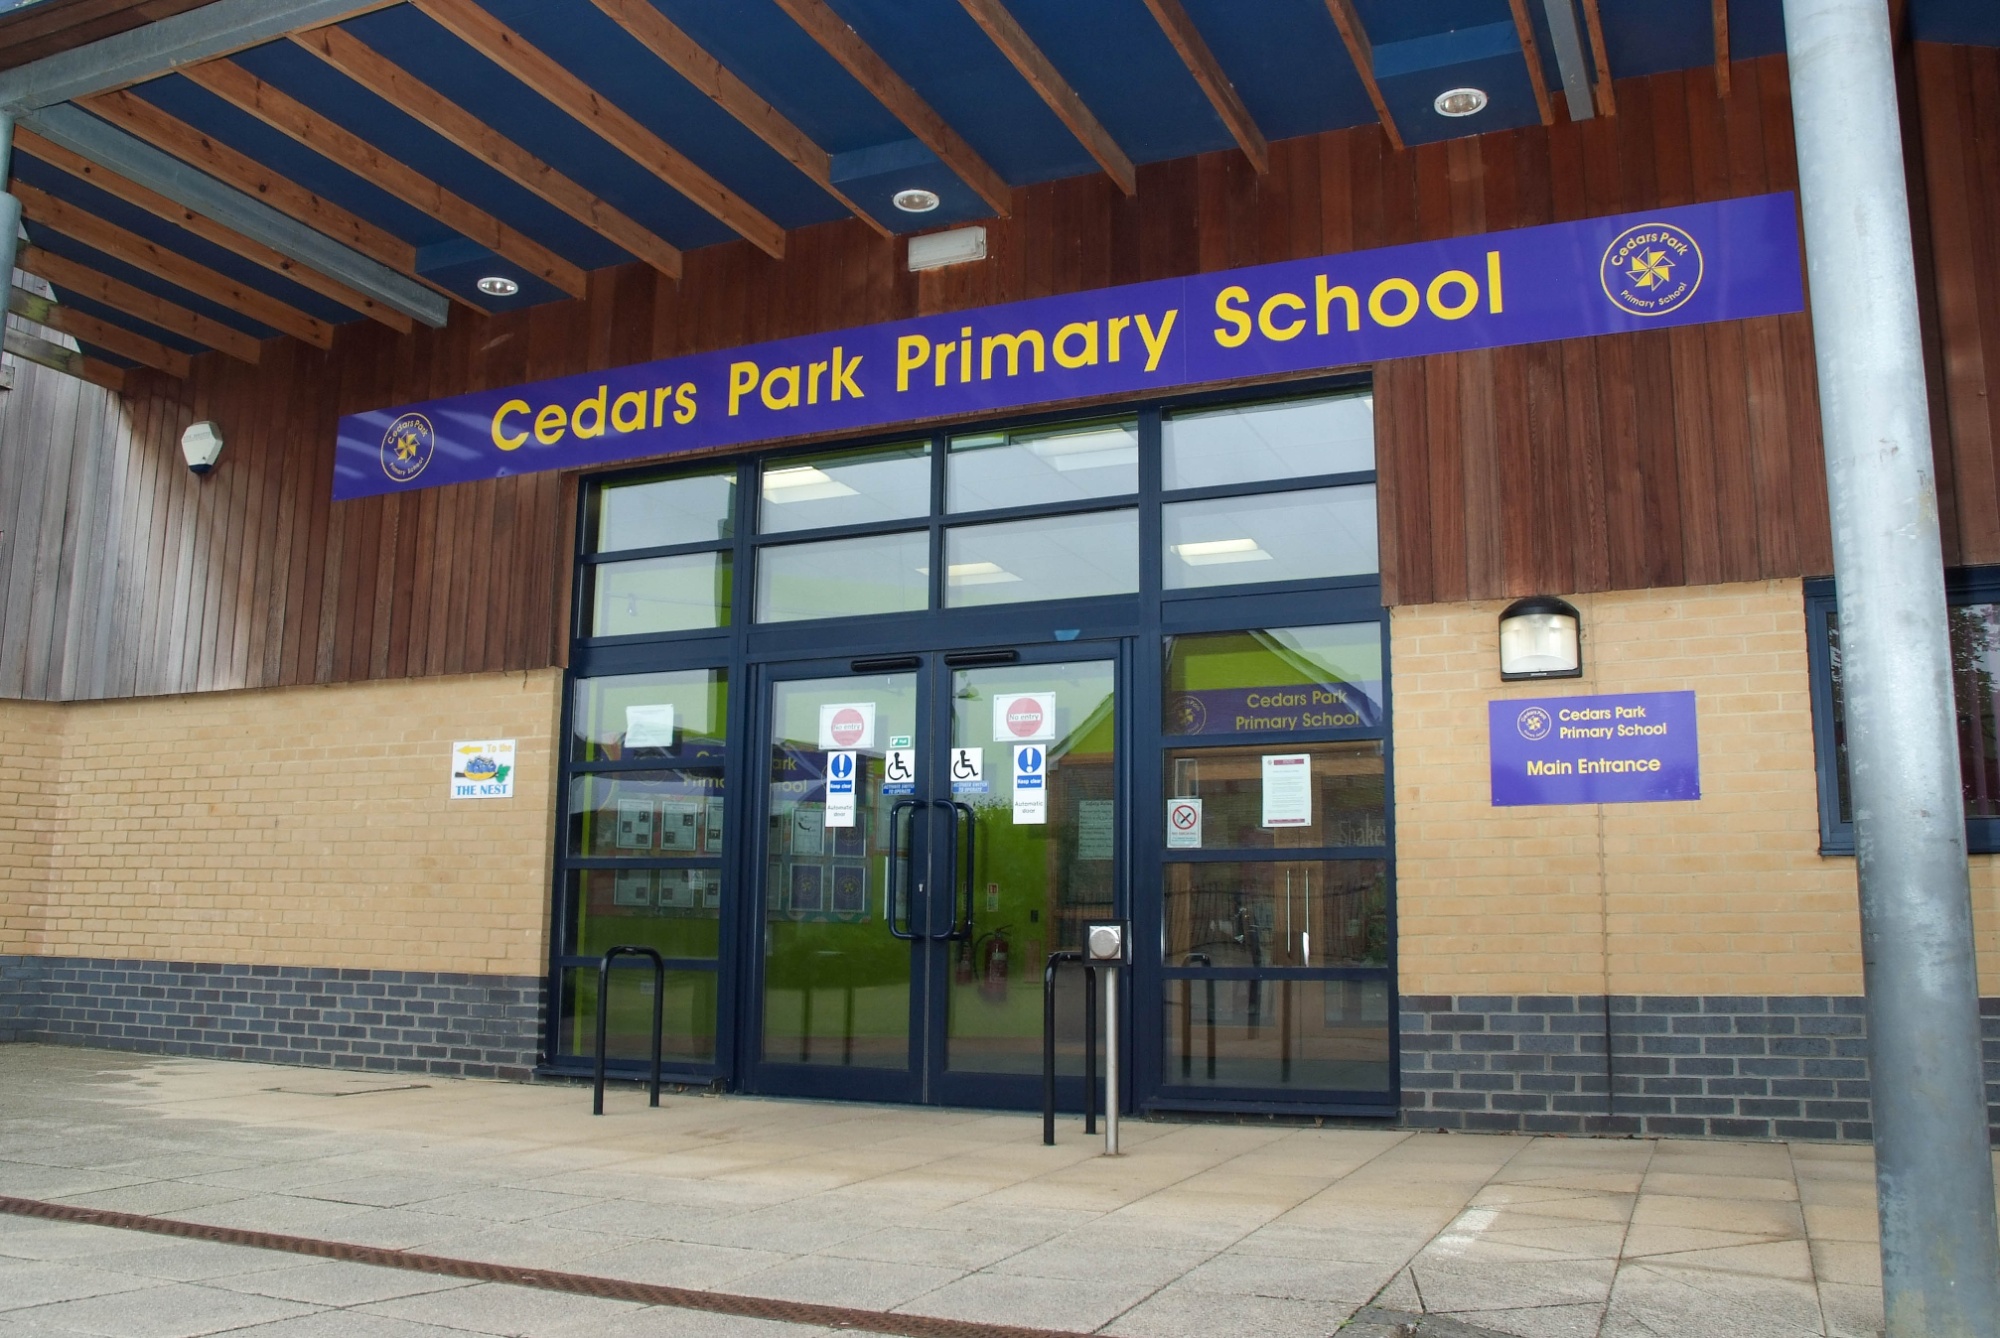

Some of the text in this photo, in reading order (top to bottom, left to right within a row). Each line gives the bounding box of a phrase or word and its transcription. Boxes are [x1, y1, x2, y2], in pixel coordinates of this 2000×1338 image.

[1611, 232, 1688, 266] Cedars Park
[1620, 282, 1688, 308] Primary School
[491, 250, 1504, 452] Cedars Park Primary School
[387, 419, 428, 445] Cedars Park
[1247, 689, 1347, 709] Cedars Park
[1020, 713, 1040, 722] entry
[1236, 712, 1360, 731] Primary School
[1558, 705, 1647, 722] Cedars Park
[1559, 725, 1614, 741] Primary
[1617, 722, 1668, 737] School
[487, 744, 497, 753] To
[772, 757, 797, 771] ark
[1526, 757, 1662, 776] Main Entrance
[456, 784, 508, 796] THE NEST
